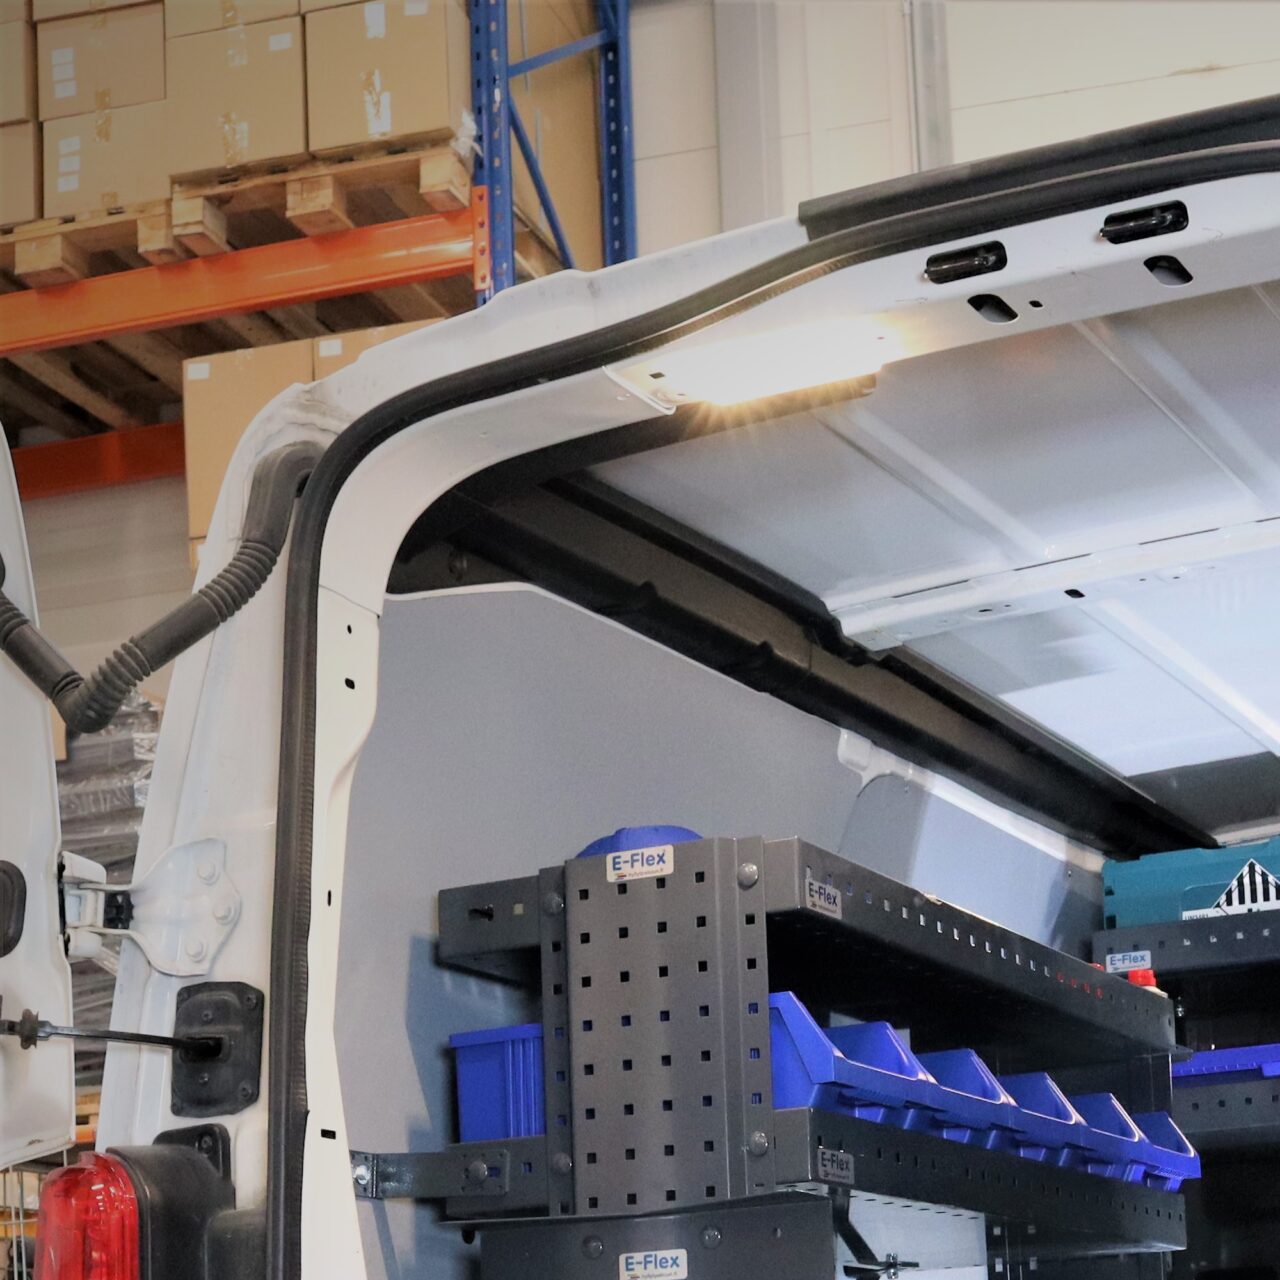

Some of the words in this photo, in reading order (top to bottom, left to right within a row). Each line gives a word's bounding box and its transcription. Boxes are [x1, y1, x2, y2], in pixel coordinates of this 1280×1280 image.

[612, 851, 666, 871] E-Flex
[809, 881, 838, 907] E-Flex
[1110, 954, 1146, 966] E-Flex
[821, 1151, 850, 1172] E-Flex
[625, 1253, 680, 1271] E-Flex
